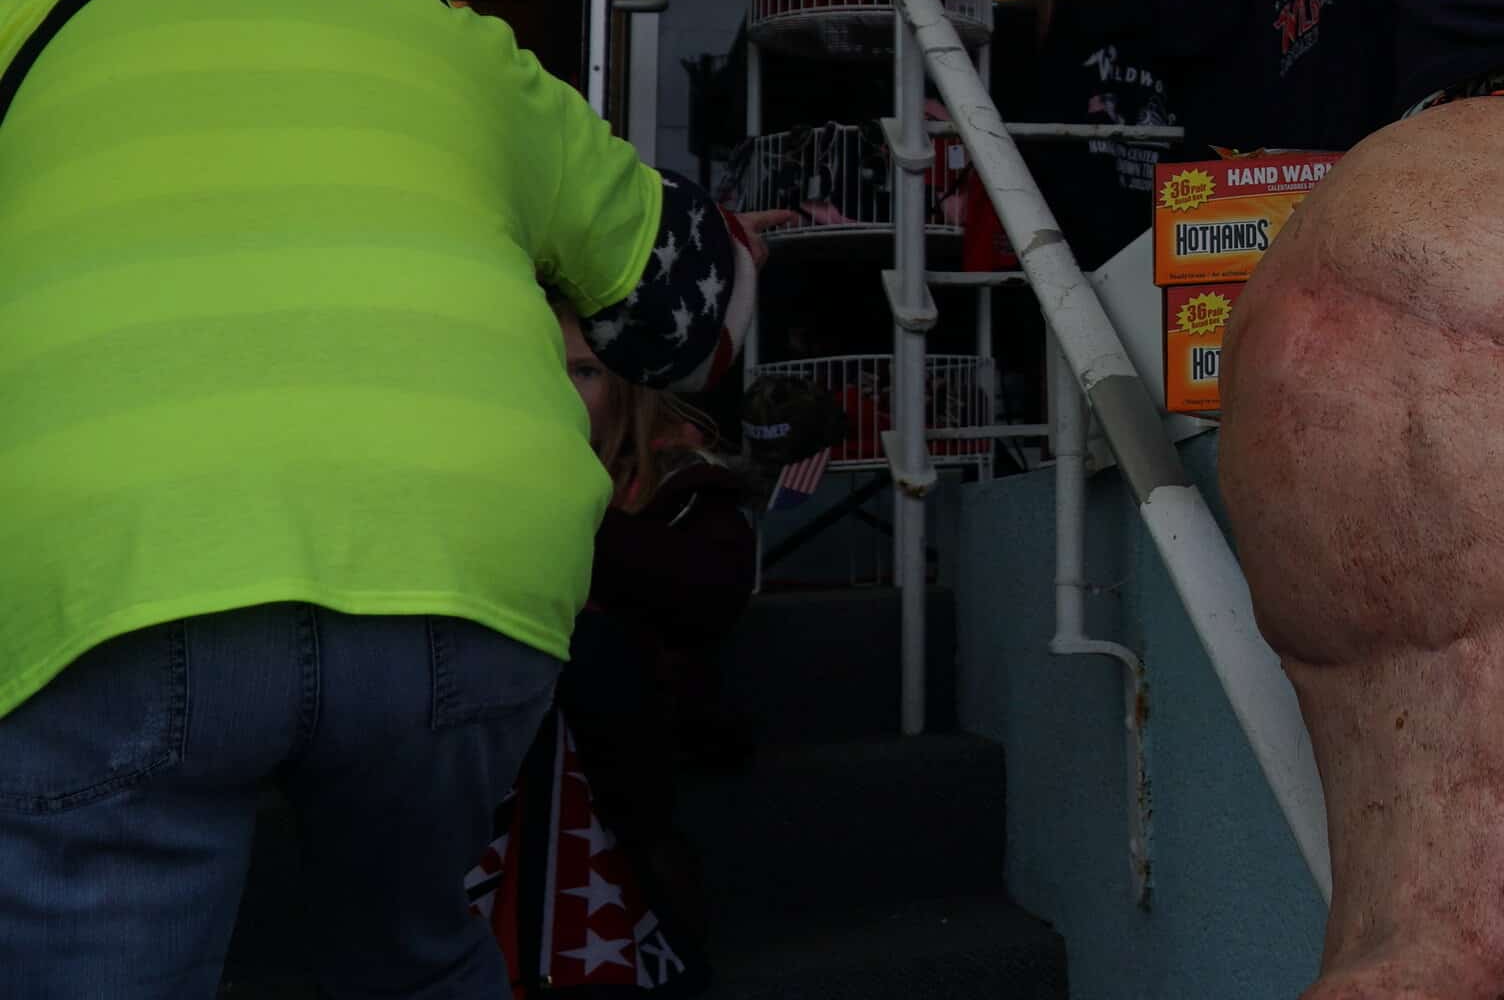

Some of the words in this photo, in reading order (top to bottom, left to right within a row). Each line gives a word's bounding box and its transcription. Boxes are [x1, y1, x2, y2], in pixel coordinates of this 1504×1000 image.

[1227, 166, 1279, 187] HAND
[1170, 179, 1190, 198] 36
[1187, 302, 1206, 322] 36
